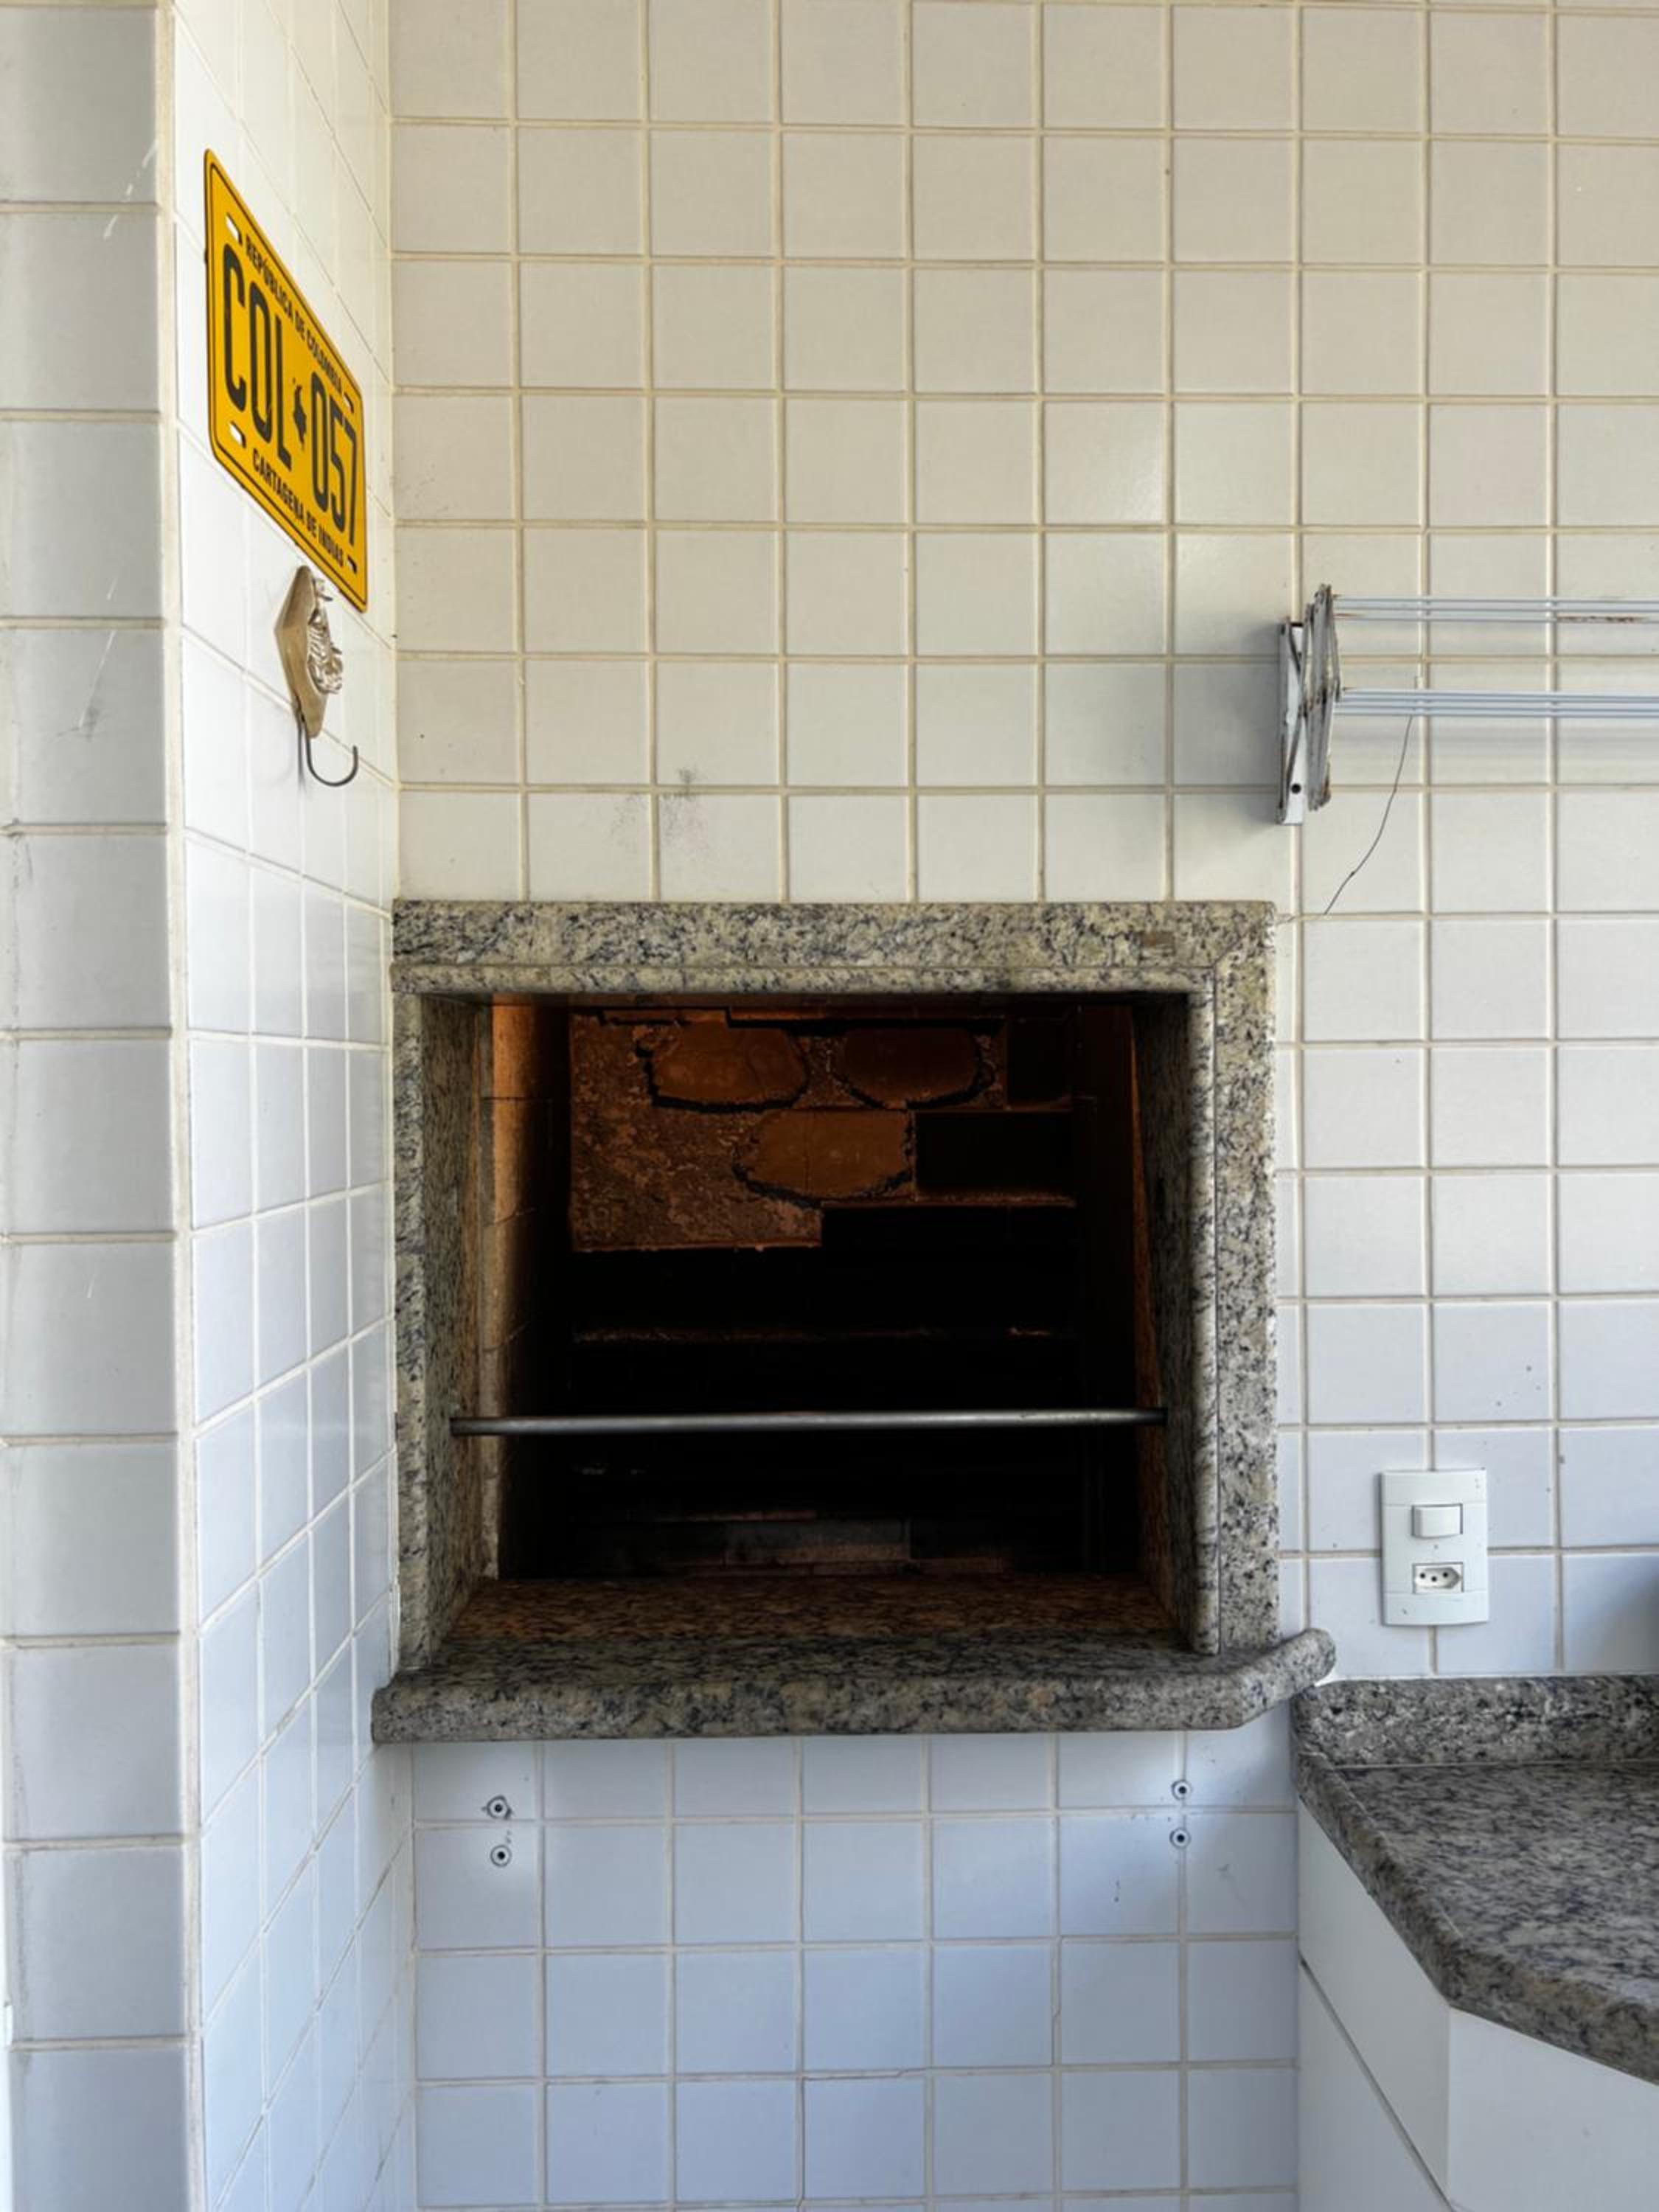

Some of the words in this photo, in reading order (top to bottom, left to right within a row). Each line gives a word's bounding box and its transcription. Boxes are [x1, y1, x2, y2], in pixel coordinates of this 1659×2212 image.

[296, 310, 306, 341] DE
[223, 243, 292, 470] COL
[310, 372, 357, 547] 057
[253, 448, 305, 524] CARTAGENA
[306, 510, 316, 538] DE
[319, 524, 344, 567] INDIAS
